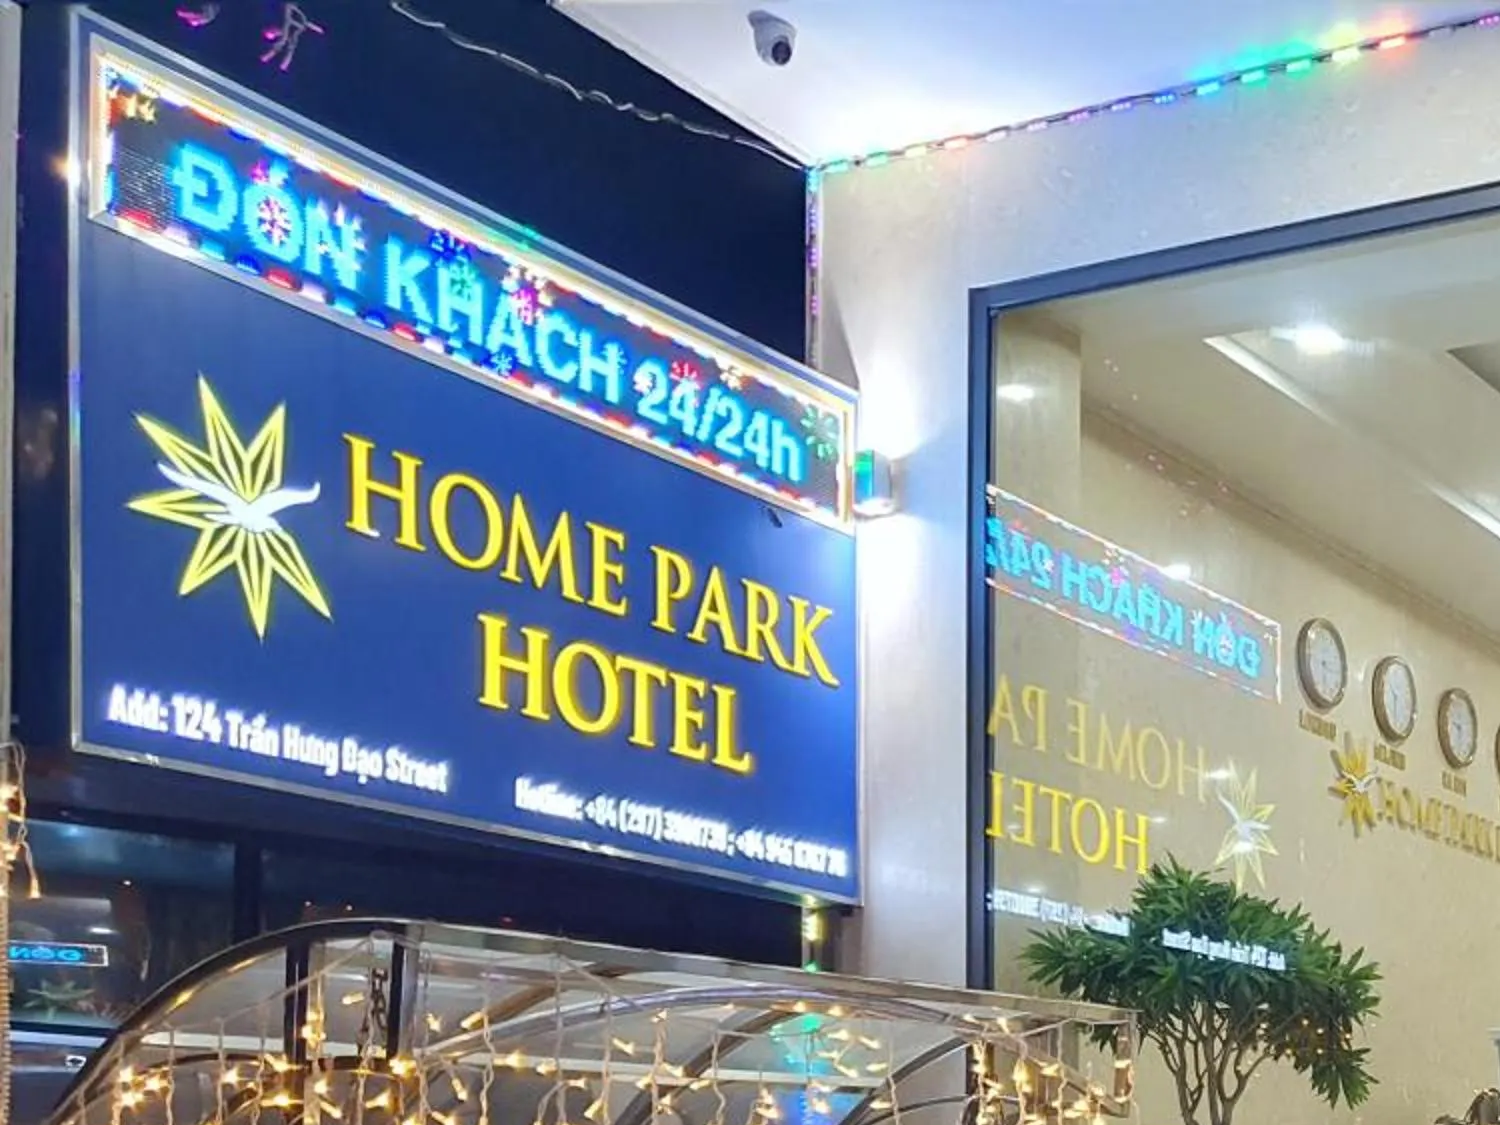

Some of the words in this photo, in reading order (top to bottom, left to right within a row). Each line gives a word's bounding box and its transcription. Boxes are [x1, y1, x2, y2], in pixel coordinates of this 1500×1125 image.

[633, 357, 801, 482] 24/24h
[343, 433, 628, 617] HOME
[650, 545, 840, 687] PARK
[107, 683, 169, 732] Add:
[171, 693, 222, 743] 124
[385, 745, 448, 793] Street
[477, 613, 755, 774] HOTEL
